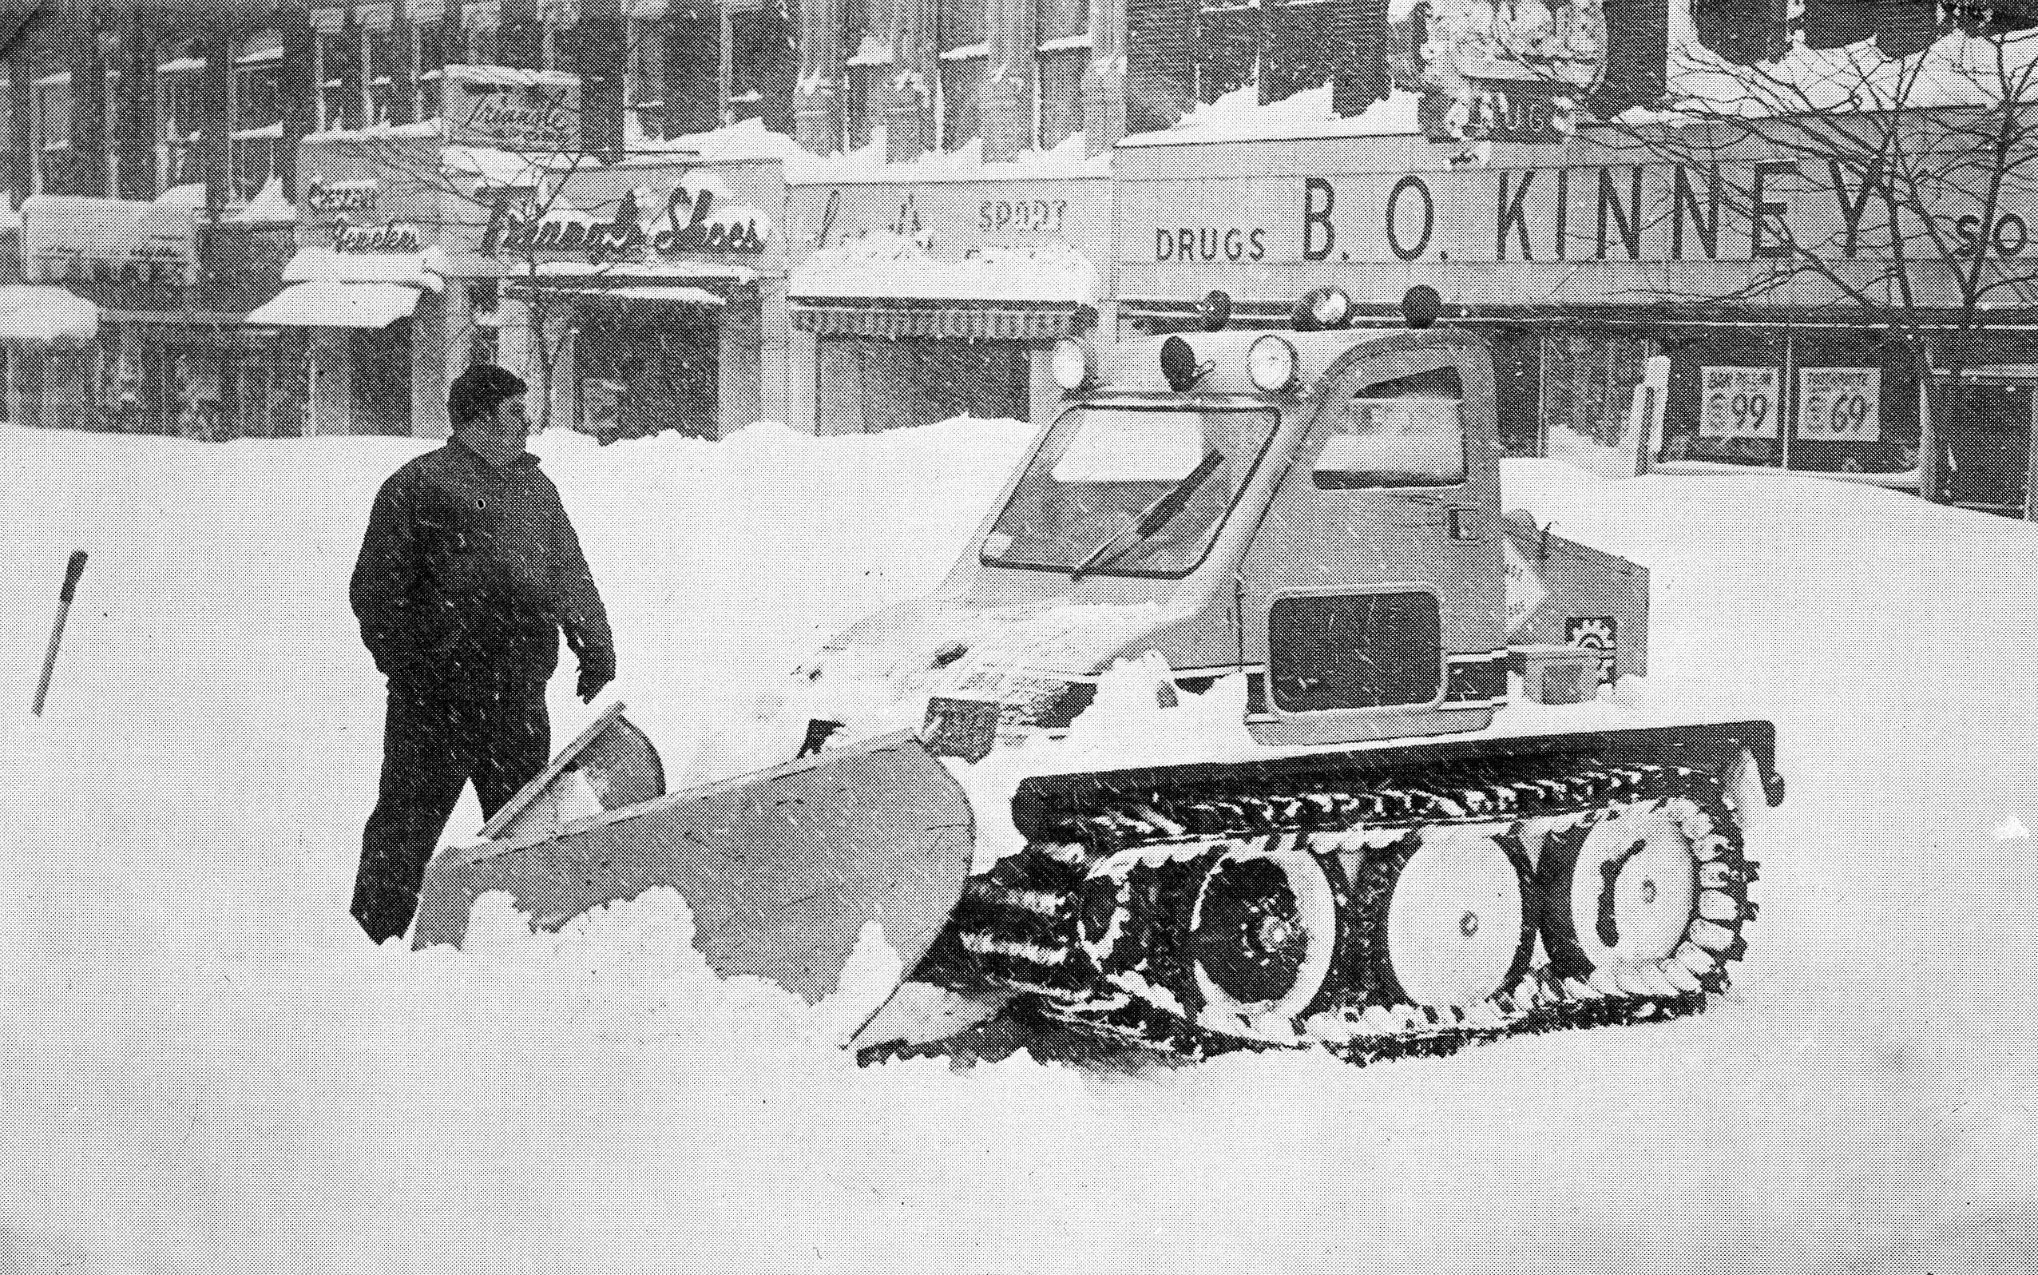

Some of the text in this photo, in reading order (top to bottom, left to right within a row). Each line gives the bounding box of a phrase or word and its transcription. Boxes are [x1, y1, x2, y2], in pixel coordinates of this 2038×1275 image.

[461, 83, 568, 131] Triangle
[473, 186, 647, 264] Triangle
[653, 187, 765, 255] Shoes
[979, 199, 1068, 232] SPORT
[1155, 227, 1267, 262] DRUGS
[1303, 177, 1350, 262] B.
[1386, 174, 1449, 262] O.
[1497, 159, 1885, 261] KINNEY
